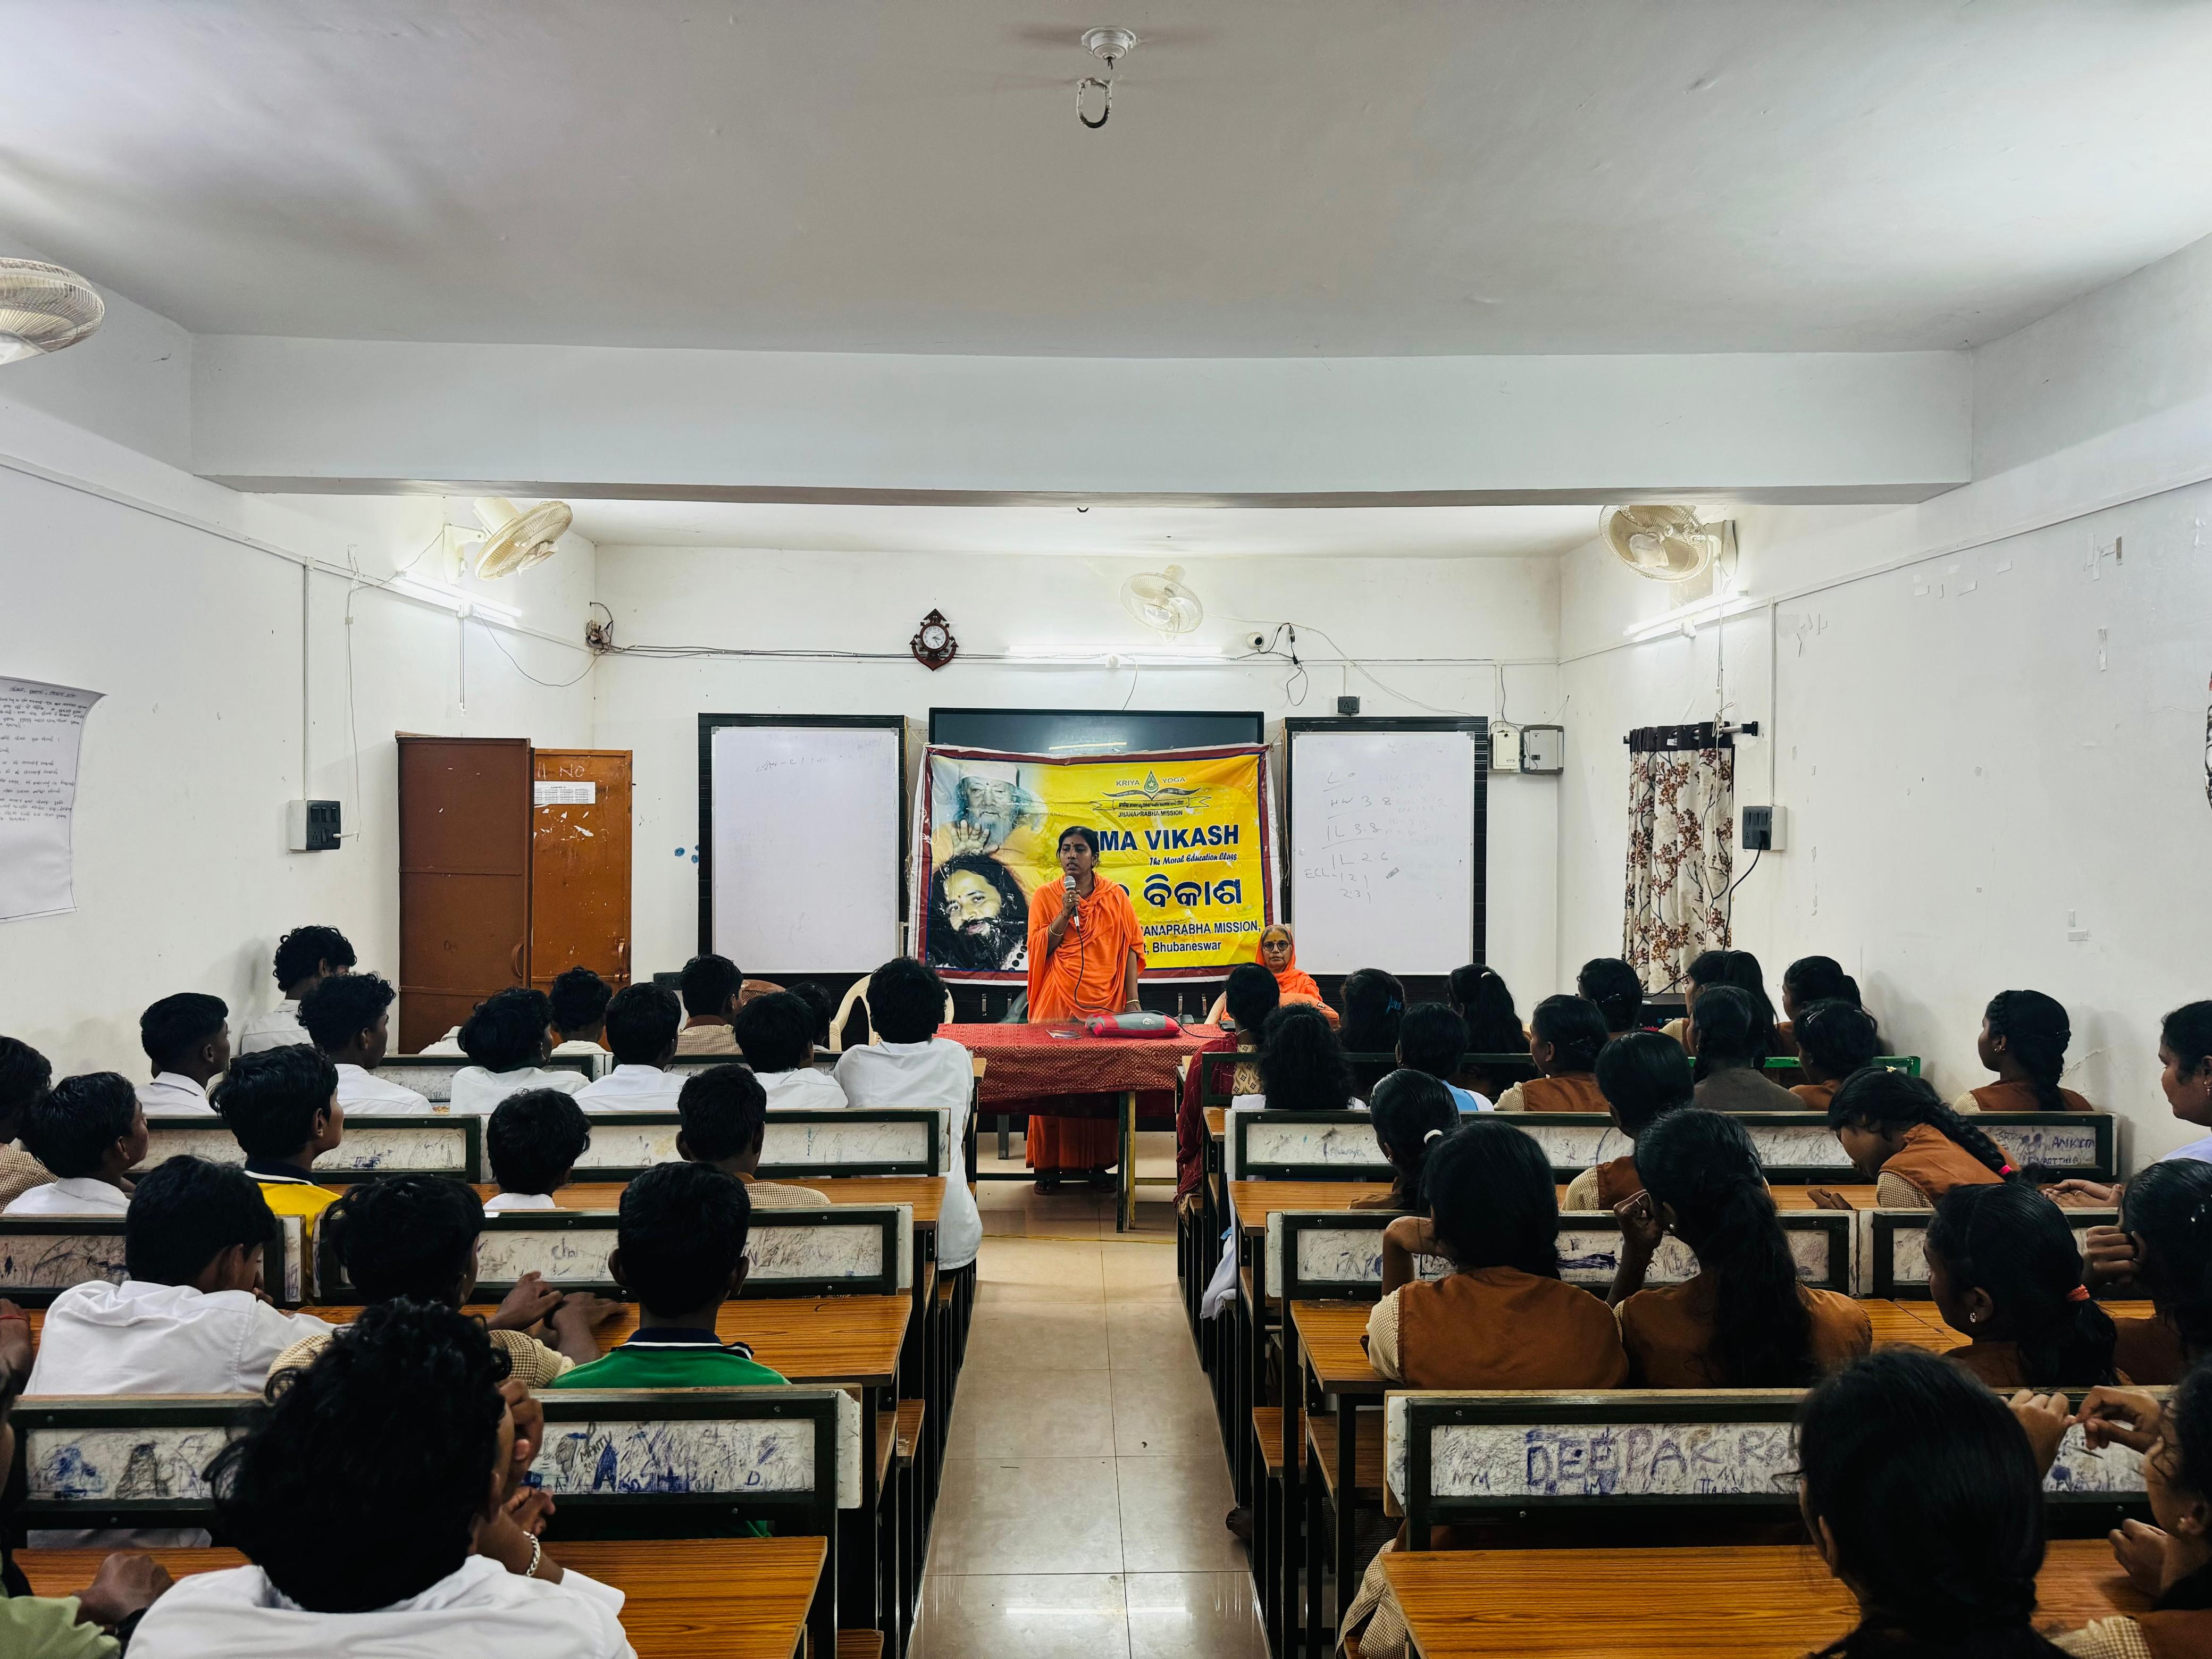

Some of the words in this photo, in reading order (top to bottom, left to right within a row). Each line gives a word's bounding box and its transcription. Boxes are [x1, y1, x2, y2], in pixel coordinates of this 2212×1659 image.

[1098, 830, 1138, 851] MA
[1144, 824, 1239, 850] VIKASH
[1149, 857, 1160, 866] The
[1162, 854, 1184, 865] Moral
[1186, 852, 1218, 862] Education
[1219, 852, 1237, 861] Class
[1143, 874, 1242, 908] ବିକାଶ
[1214, 920, 1261, 934] MISSION,
[1152, 941, 1222, 953] Bhubaneswar
